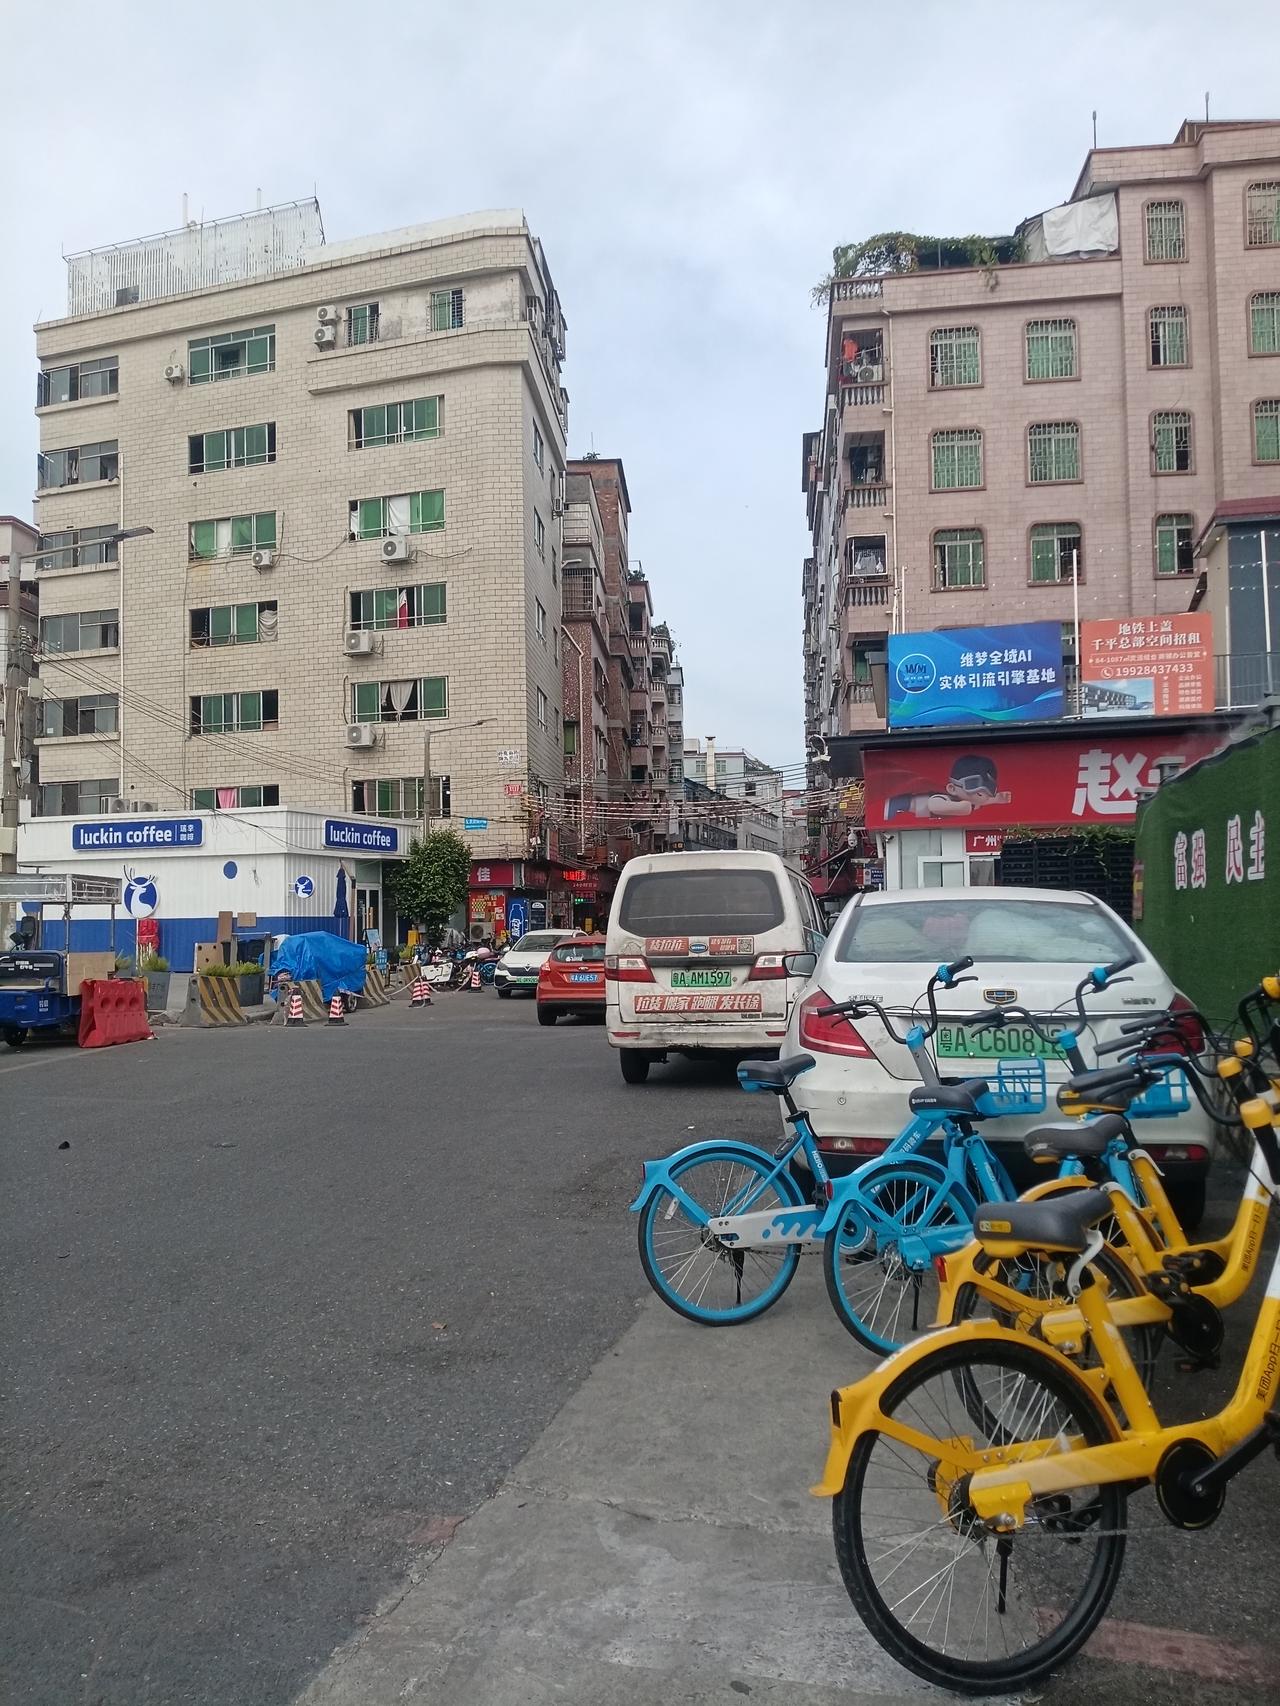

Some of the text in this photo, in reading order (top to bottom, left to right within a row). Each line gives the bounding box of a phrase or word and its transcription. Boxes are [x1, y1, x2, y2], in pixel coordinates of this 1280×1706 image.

[1118, 620, 1173, 635] 地铁上盖
[1091, 632, 1201, 650] 千平总部空间招租
[960, 649, 1032, 668] 维梦全域AI
[1116, 663, 1193, 677] 19928437433
[939, 667, 1056, 691] 实体引流引擎基地
[1072, 748, 1161, 817] 赵
[80, 825, 172, 845] luckin coffee
[180, 824, 194, 833] 瑞幸
[180, 833, 194, 841] 咖啡
[330, 825, 391, 847] luckin coffee
[973, 834, 1002, 847] 广州
[1226, 810, 1265, 884] 民主
[1174, 831, 1206, 890] 富强
[477, 867, 491, 882] 佳
[649, 939, 686, 952] 货拉拉
[636, 995, 760, 1011] 拉货 搬家 跑腿 发长途
